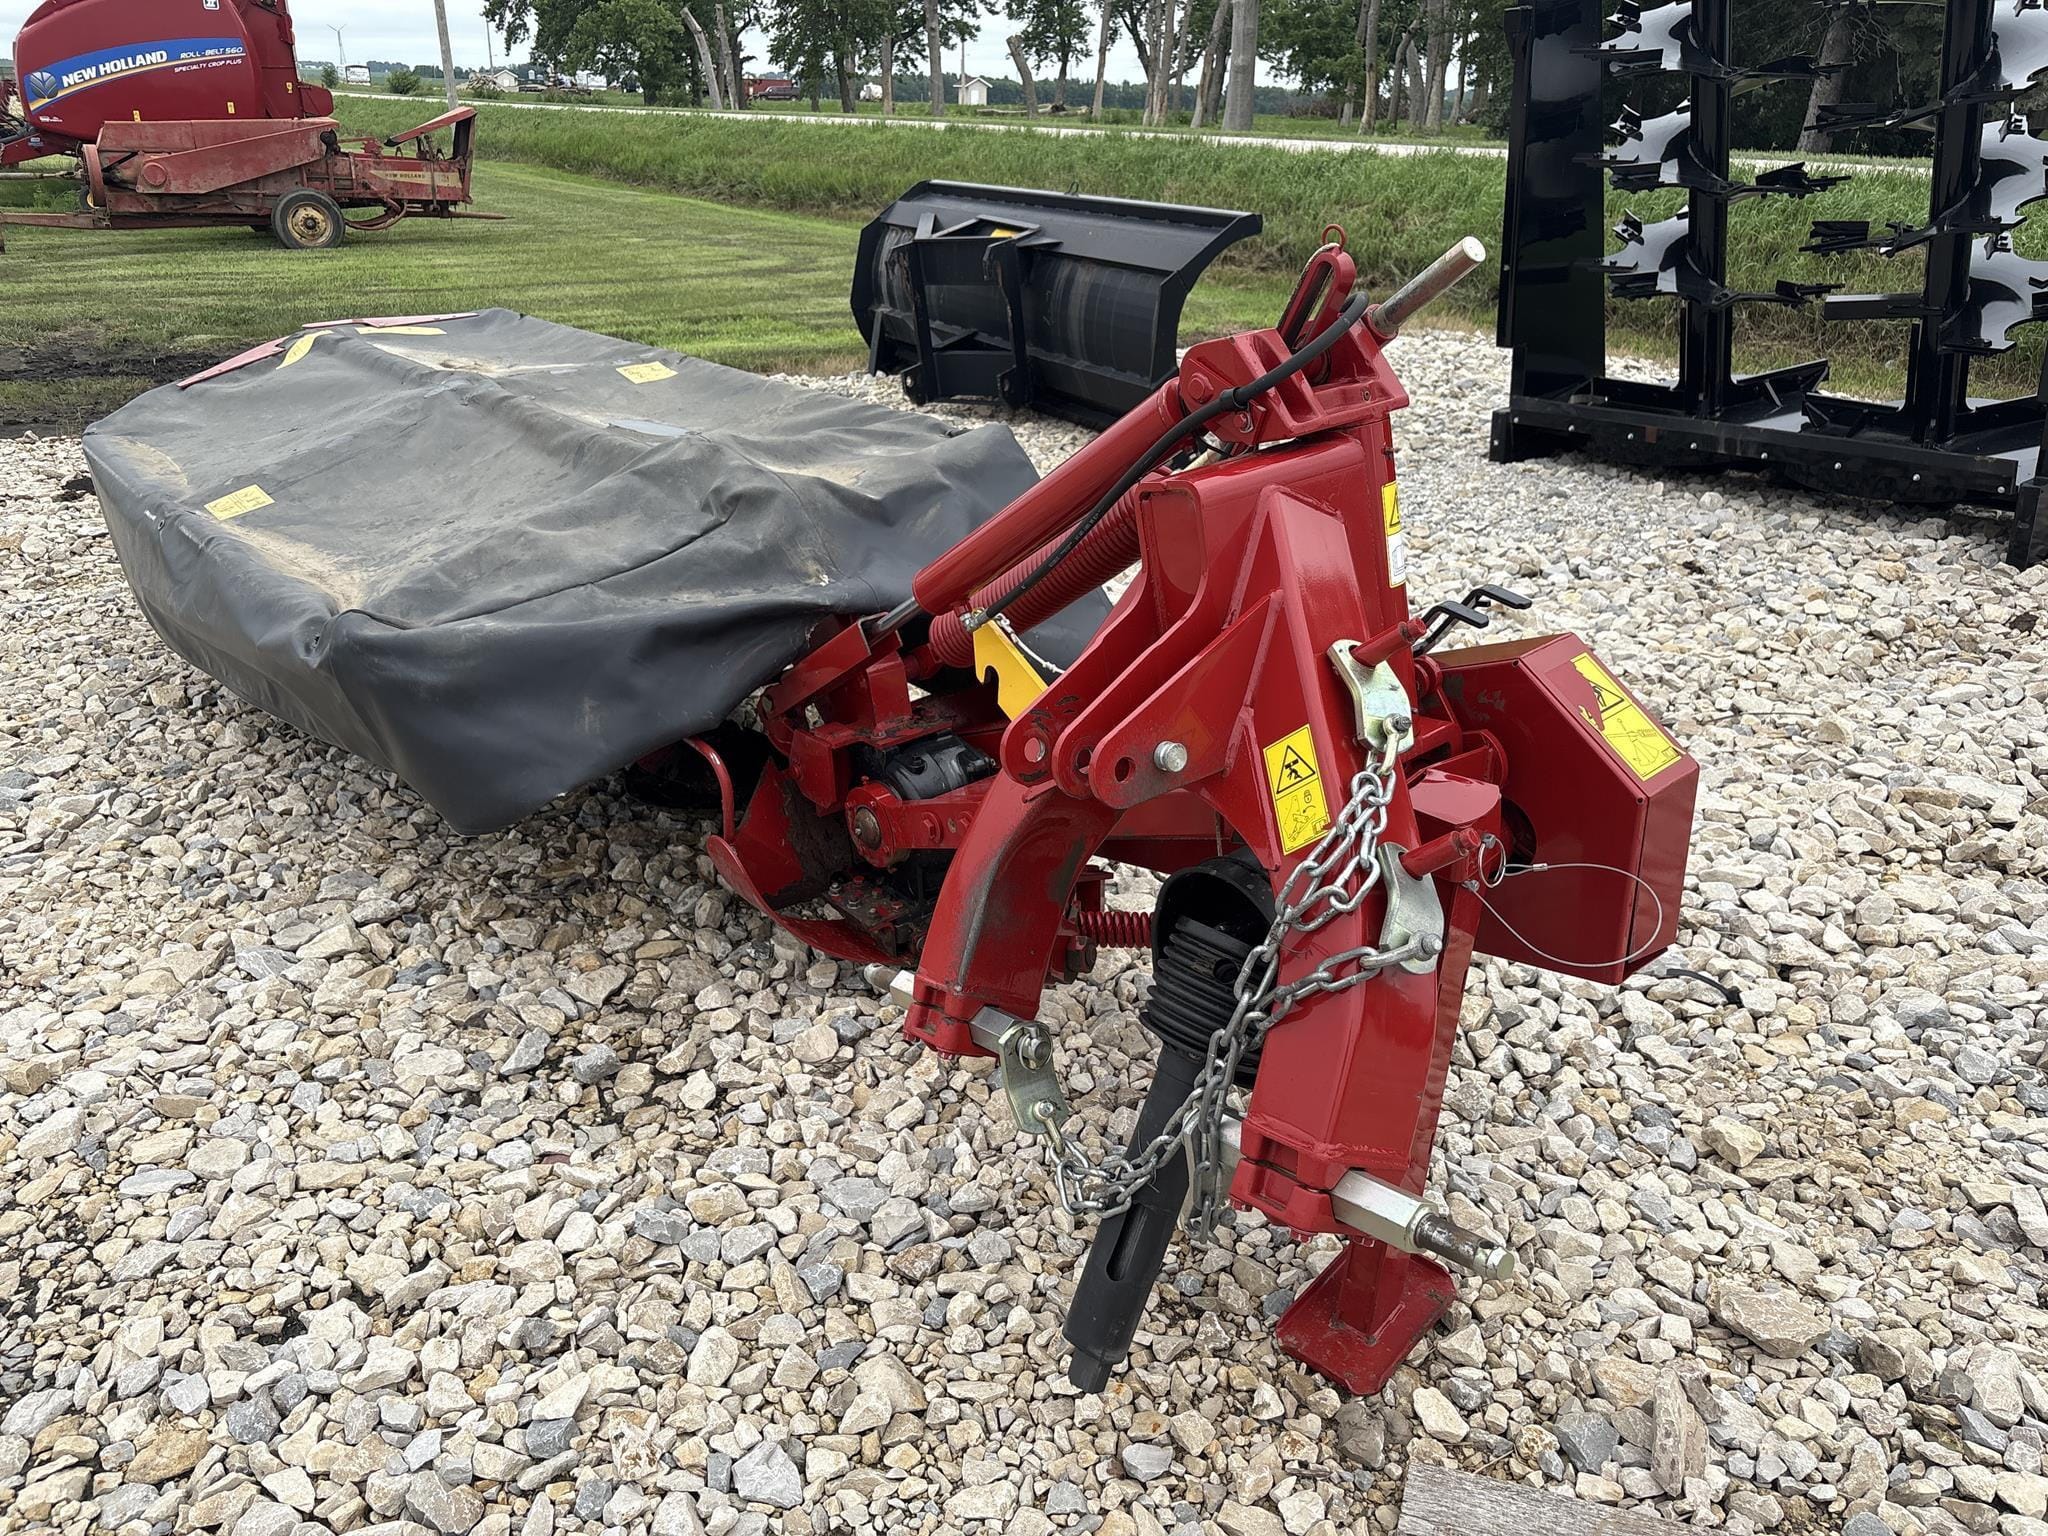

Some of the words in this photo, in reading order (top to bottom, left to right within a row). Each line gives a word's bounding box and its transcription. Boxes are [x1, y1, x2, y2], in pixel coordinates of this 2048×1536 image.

[225, 46, 243, 54] 560
[62, 66, 96, 87] NEW
[98, 50, 168, 75] HOLLAND
[174, 62, 207, 73] SPECIALTY
[207, 60, 226, 68] CROP
[226, 58, 242, 66] PLUS
